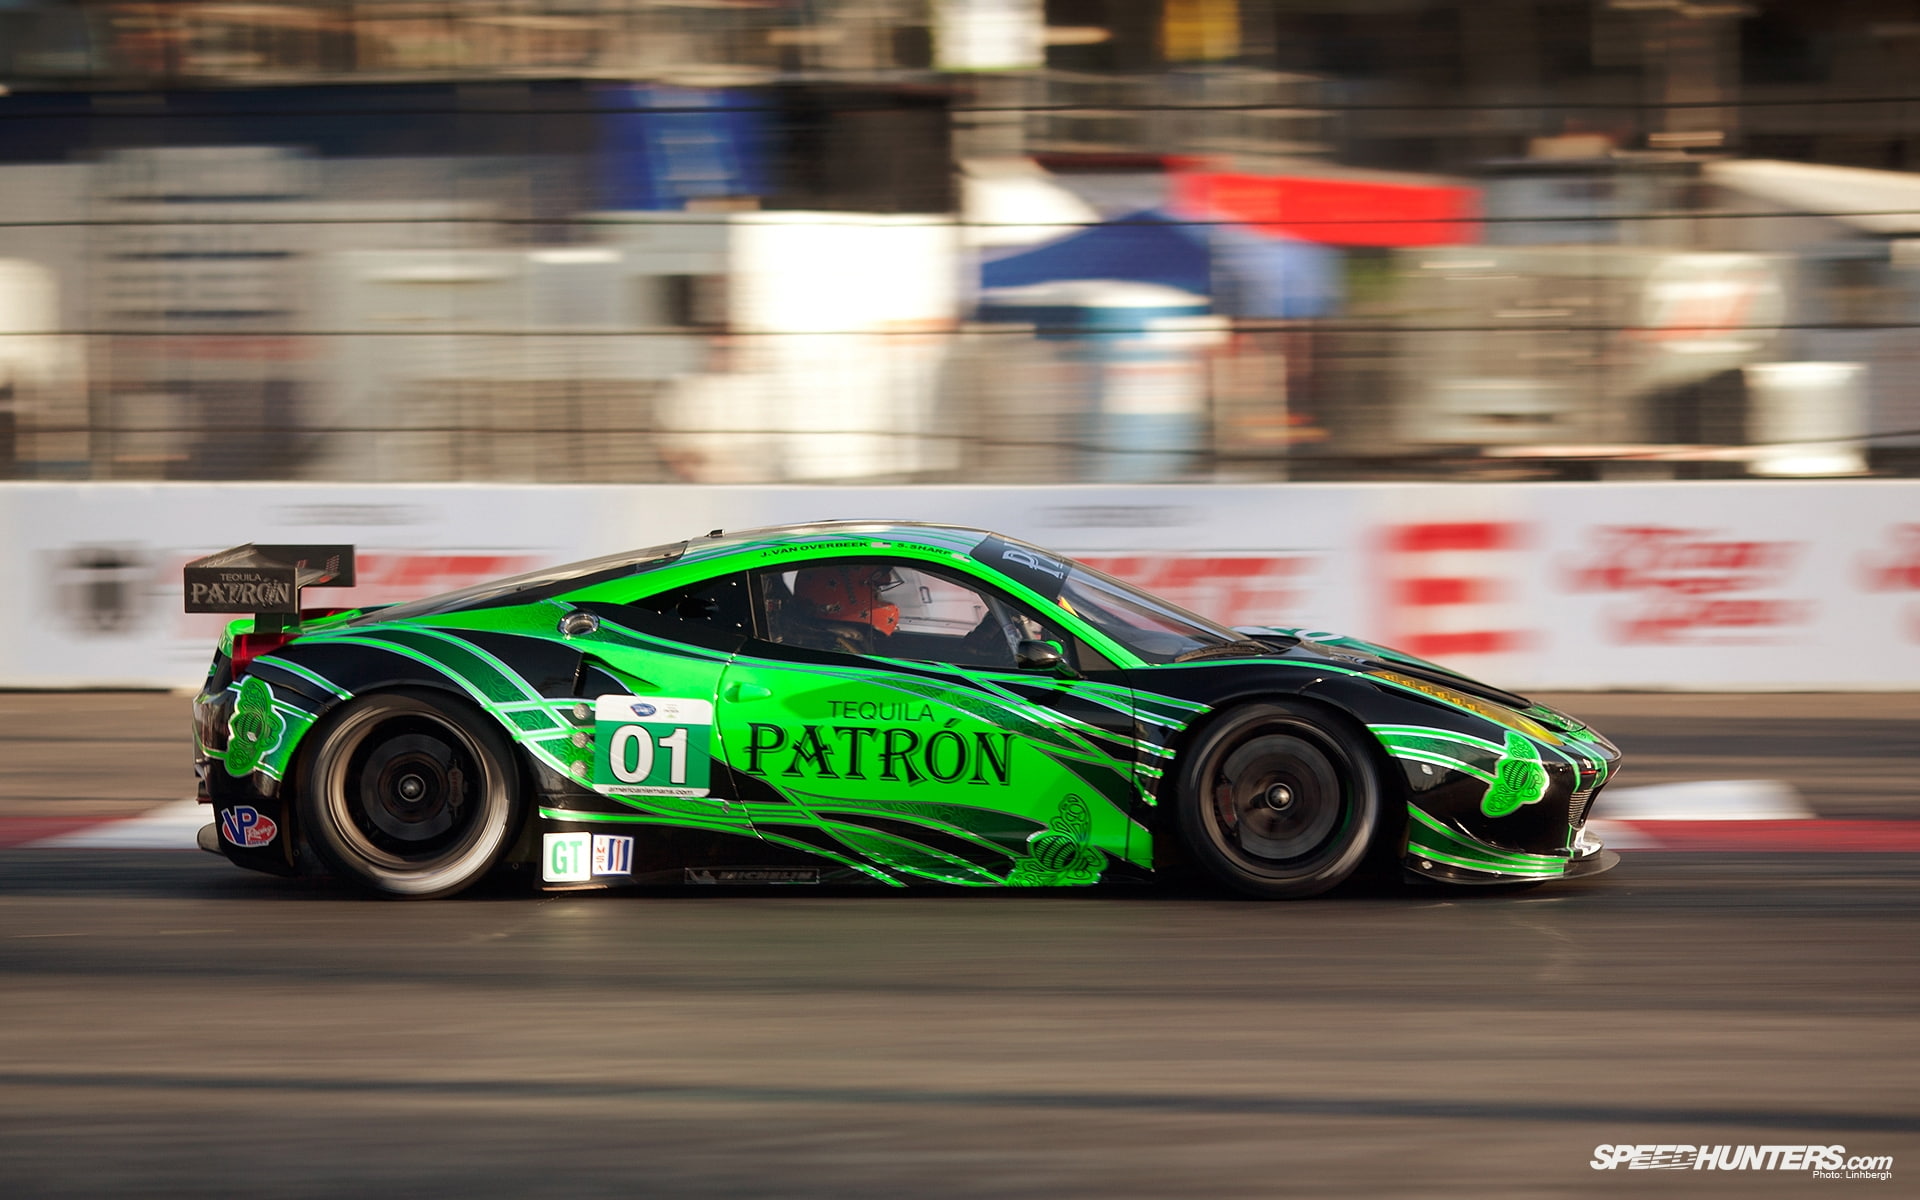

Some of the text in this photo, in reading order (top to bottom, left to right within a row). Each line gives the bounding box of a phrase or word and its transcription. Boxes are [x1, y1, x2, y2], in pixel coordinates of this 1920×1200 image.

[772, 546, 798, 555] VAN
[799, 542, 868, 551] OVERBEEK
[909, 544, 952, 555] SHARP
[220, 573, 262, 582] TEQUILA
[191, 578, 291, 606] PATRÓN
[828, 700, 935, 722] TEQUILA
[609, 724, 688, 784] 01
[744, 718, 1017, 787] PATRÓN
[221, 805, 259, 847] VP
[552, 840, 583, 875] GT
